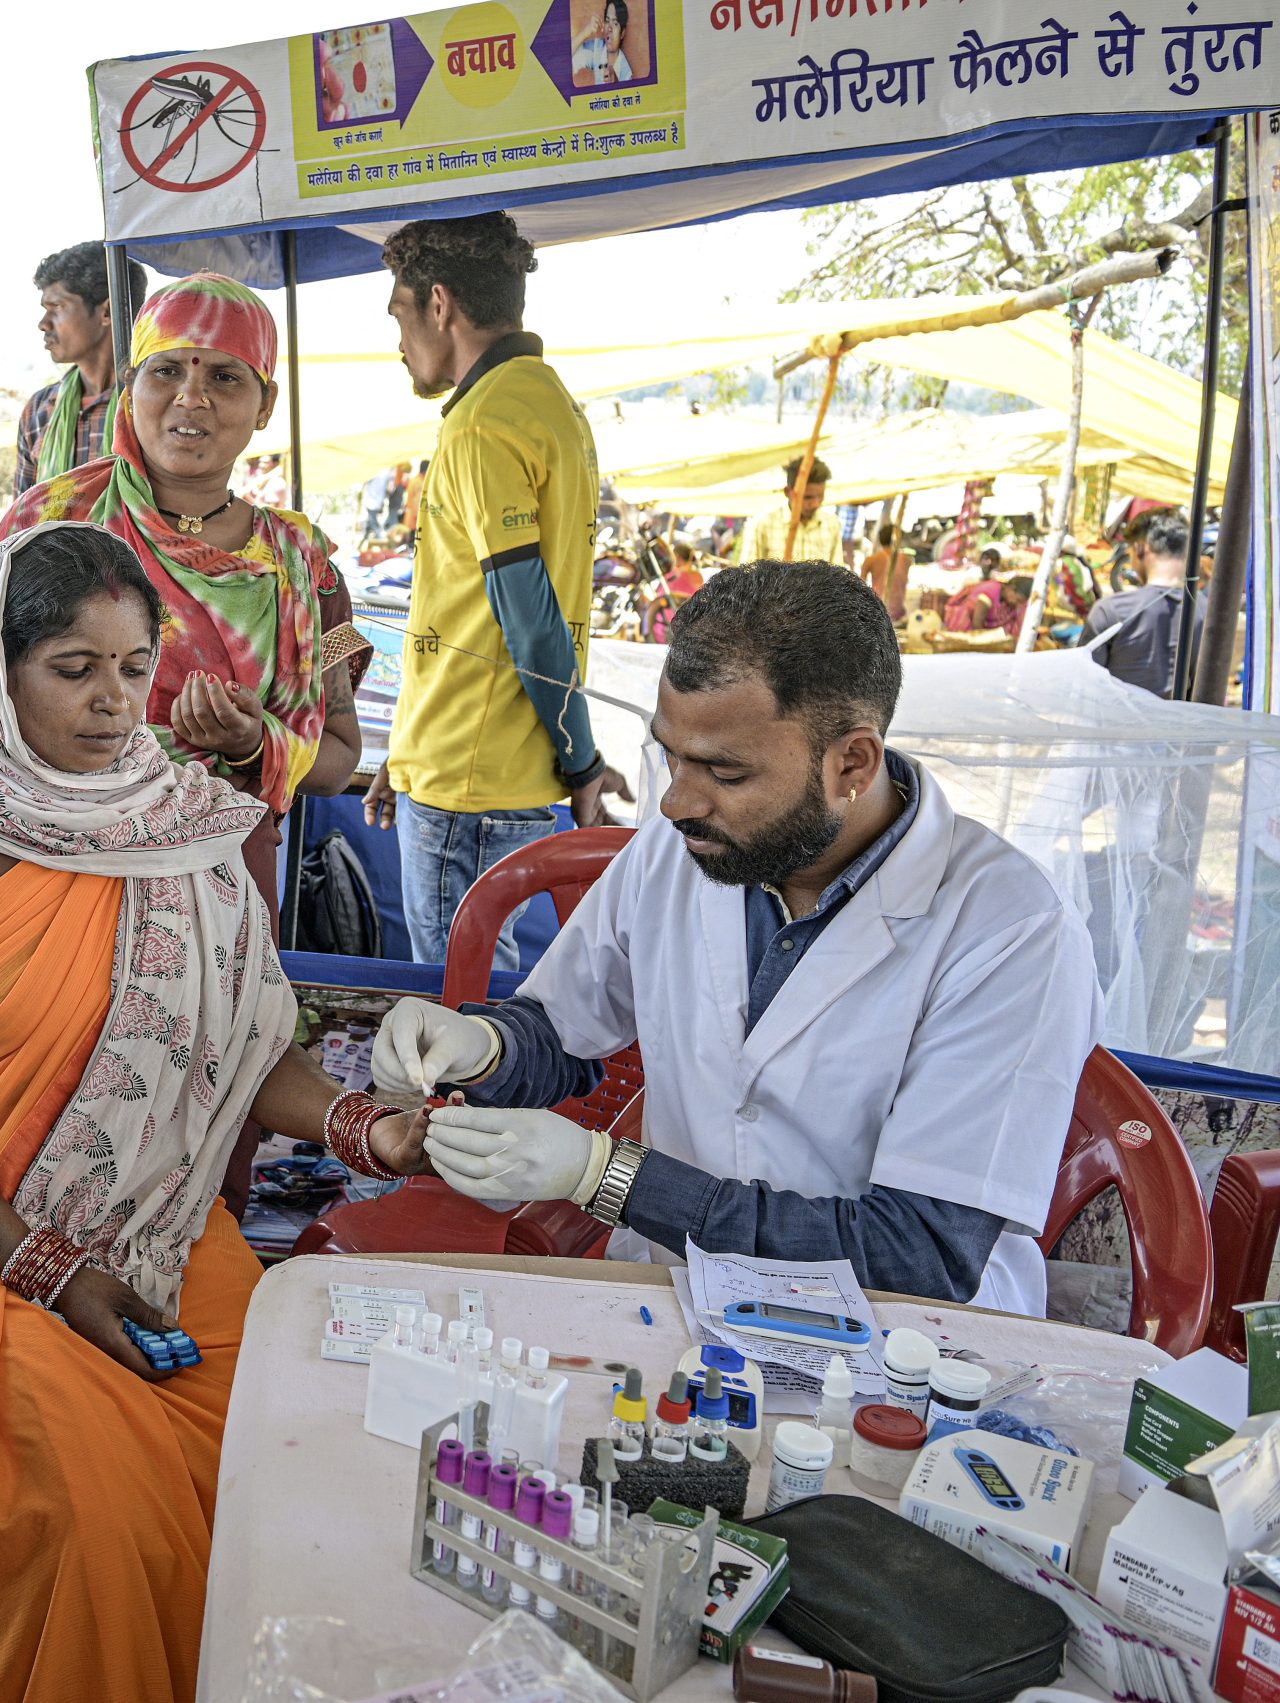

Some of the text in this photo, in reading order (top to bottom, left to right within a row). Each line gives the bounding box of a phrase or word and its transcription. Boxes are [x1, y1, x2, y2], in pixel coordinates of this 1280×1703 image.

[444, 32, 518, 79] बचाव
[752, 48, 935, 123] मलेरिया
[949, 18, 1079, 95] फैलने
[1095, 10, 1146, 79] से
[612, 94, 621, 108] की
[622, 96, 633, 108] दवा
[345, 132, 353, 143] की
[307, 167, 343, 187] मलेरिया
[347, 163, 361, 183] की
[365, 165, 384, 183] दवा
[387, 163, 400, 181] हर
[403, 156, 422, 175] गांव
[426, 153, 435, 172] में
[438, 150, 479, 170] मितानिन
[482, 146, 498, 168] एवं
[501, 145, 538, 163] स्वास्थ्य
[571, 134, 581, 152] में
[629, 128, 668, 145] उपलब्ध
[670, 121, 679, 145] है
[413, 626, 442, 656] बचे
[1128, 1121, 1148, 1134] ISO
[1145, 1404, 1181, 1430] COMPONENTS
[1114, 1550, 1149, 1571] STANDARD
[1112, 1558, 1144, 1577] Malaria
[1172, 1585, 1185, 1597] Ag
[1234, 1606, 1250, 1619] HIV
[1263, 1621, 1276, 1634] Ab
[1236, 1599, 1267, 1619] STANDARD
